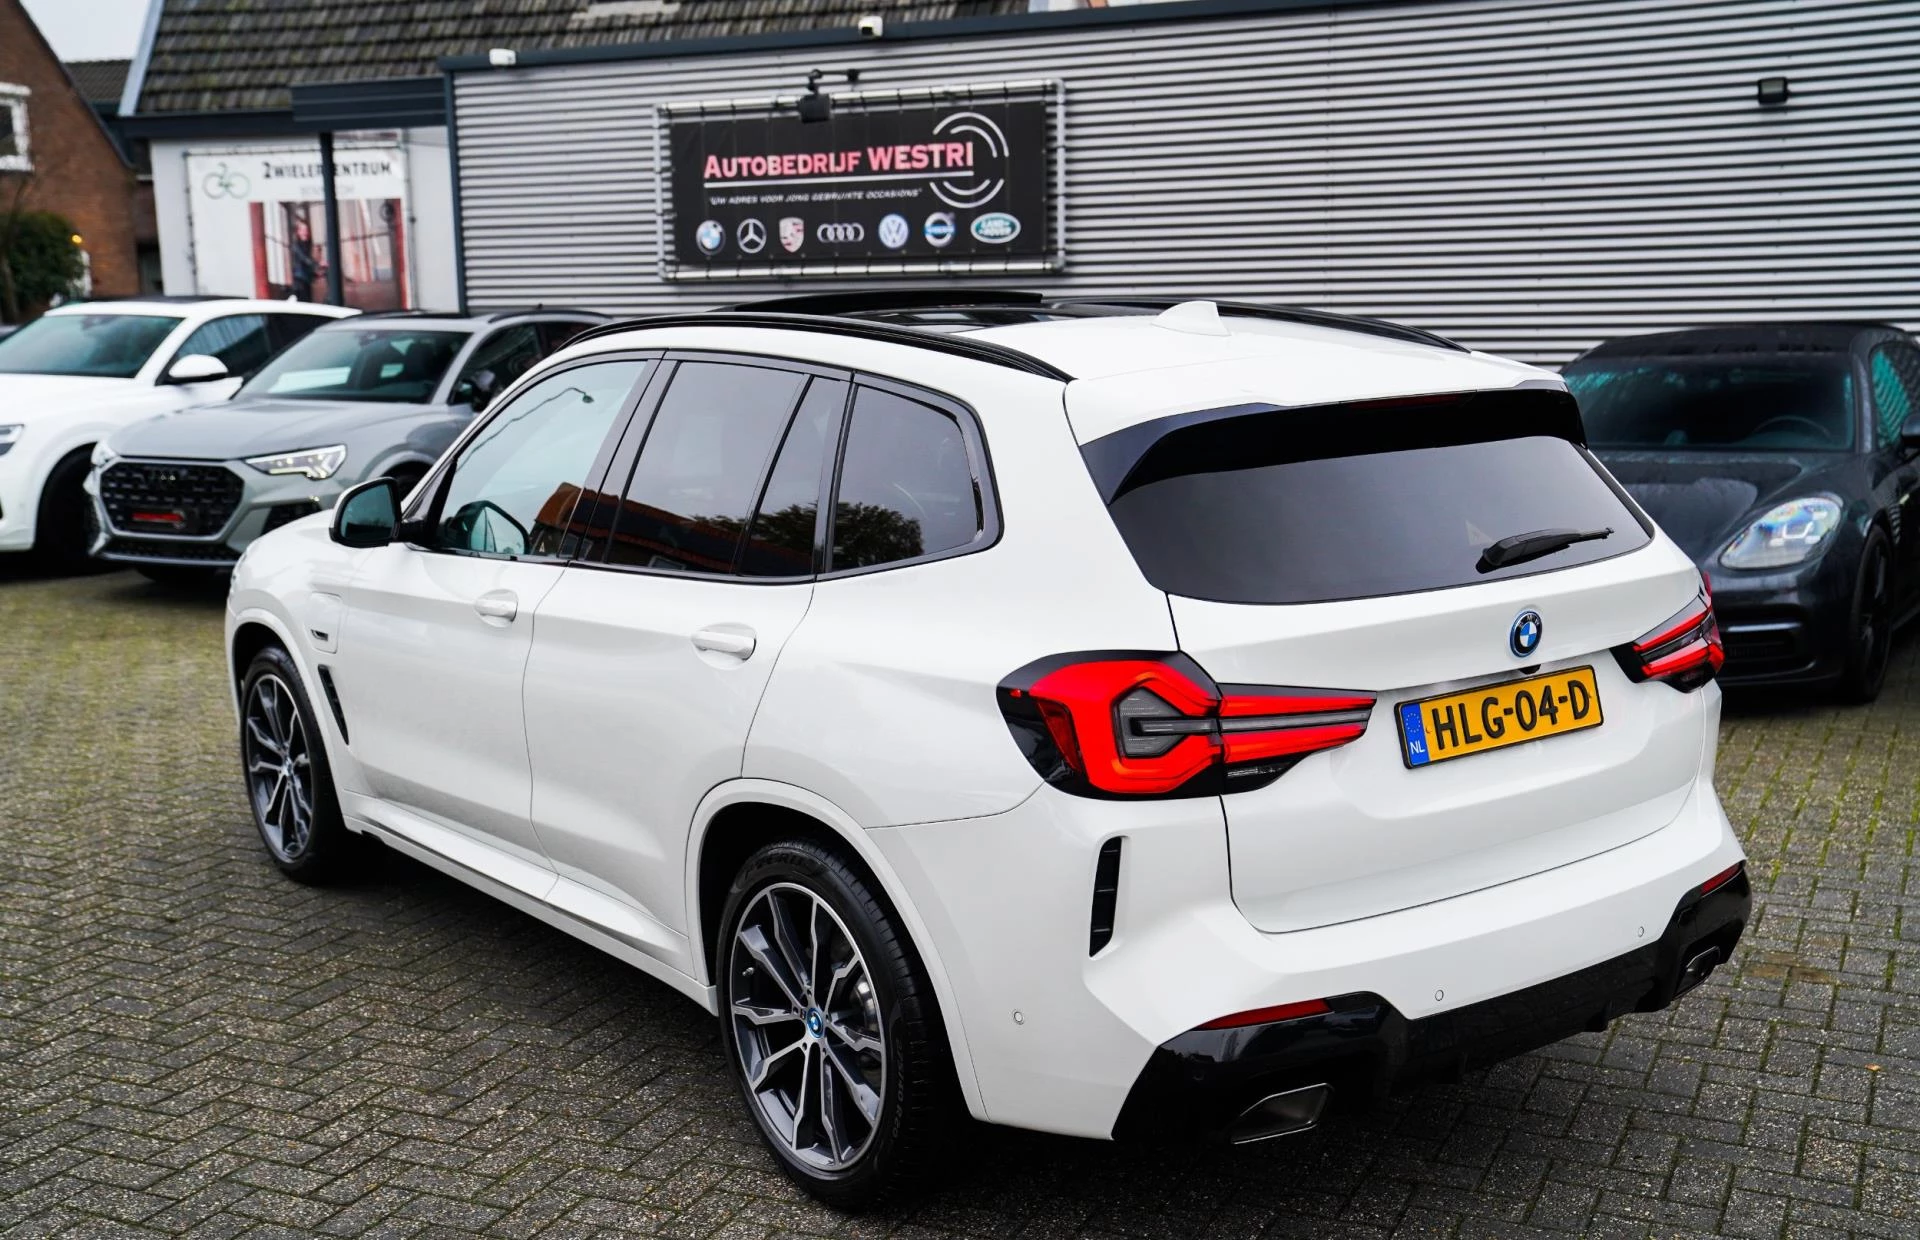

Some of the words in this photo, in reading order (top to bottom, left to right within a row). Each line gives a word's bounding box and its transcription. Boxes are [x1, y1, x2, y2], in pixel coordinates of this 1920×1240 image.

[704, 151, 861, 179] AUTOBEDRIJF
[867, 142, 973, 171] WESTRI
[1432, 679, 1590, 751] HLG-04-D
[1410, 741, 1426, 755] NL
